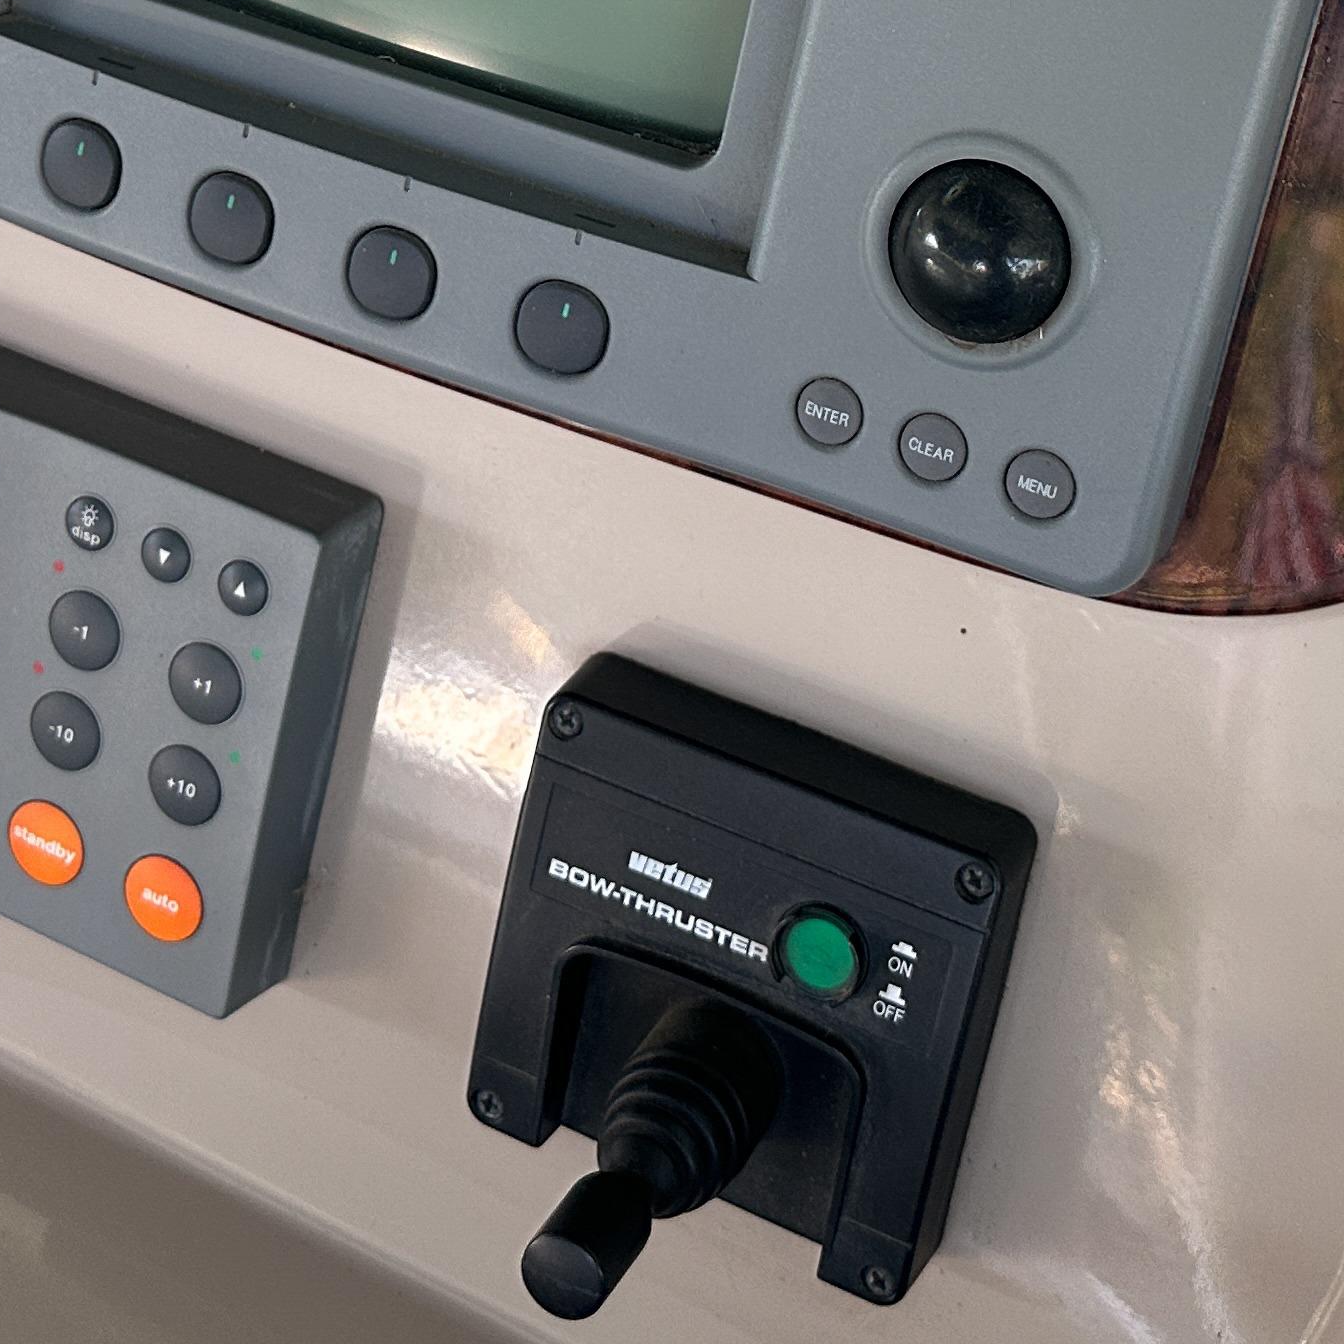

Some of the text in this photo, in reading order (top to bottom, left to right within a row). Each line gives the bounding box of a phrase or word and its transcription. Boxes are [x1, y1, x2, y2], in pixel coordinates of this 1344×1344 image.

[804, 400, 849, 427] ENTER
[908, 436, 954, 463] CLEAR
[1017, 474, 1057, 500] MENU
[71, 524, 101, 547] disp
[72, 624, 89, 641] -1
[193, 676, 212, 696] +1
[47, 723, 75, 745] -10
[166, 777, 197, 799] +10
[13, 822, 76, 865] standby
[628, 850, 713, 900] vetus
[141, 886, 180, 914] auto
[548, 857, 770, 963] BOW-THRUSTER
[887, 955, 913, 979] ON
[872, 999, 906, 1024] OFF
